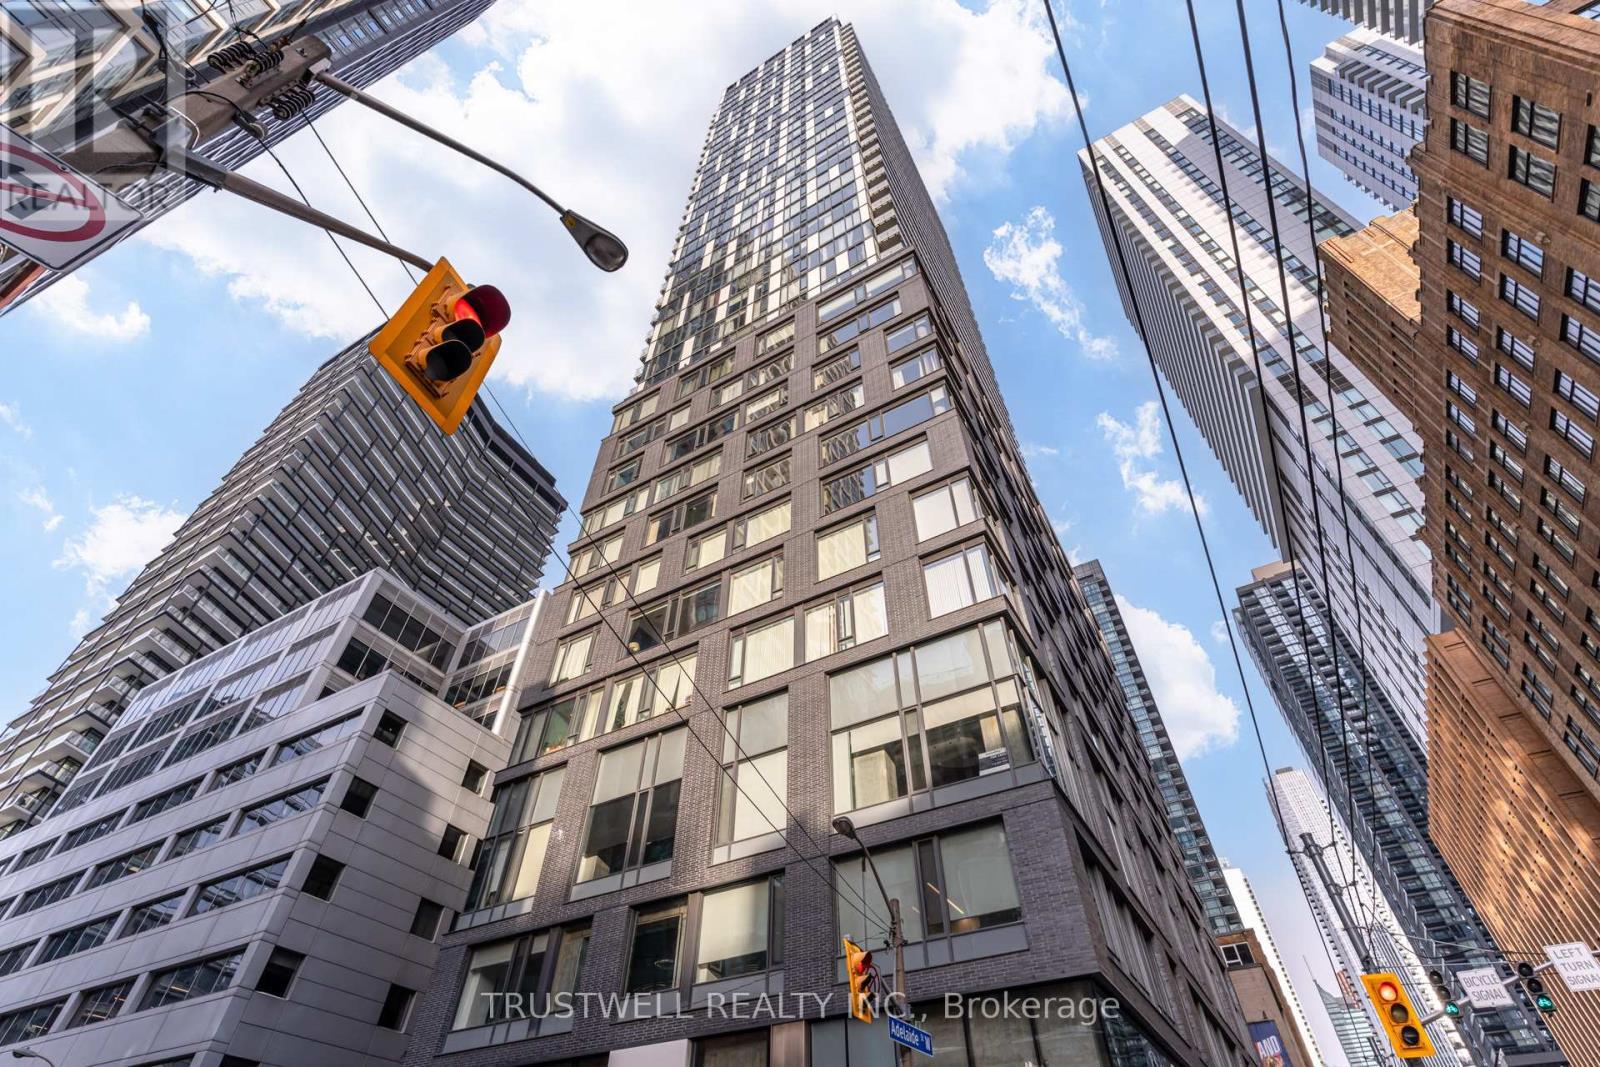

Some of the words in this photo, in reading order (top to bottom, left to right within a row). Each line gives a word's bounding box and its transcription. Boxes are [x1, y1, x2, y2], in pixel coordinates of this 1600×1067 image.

[1552, 947, 1583, 960] LEFT
[1560, 960, 1595, 972] TURN
[1463, 973, 1499, 988] BICYCLE
[1472, 988, 1507, 1002] SIGNAL
[890, 1019, 919, 1047] Adelaide
